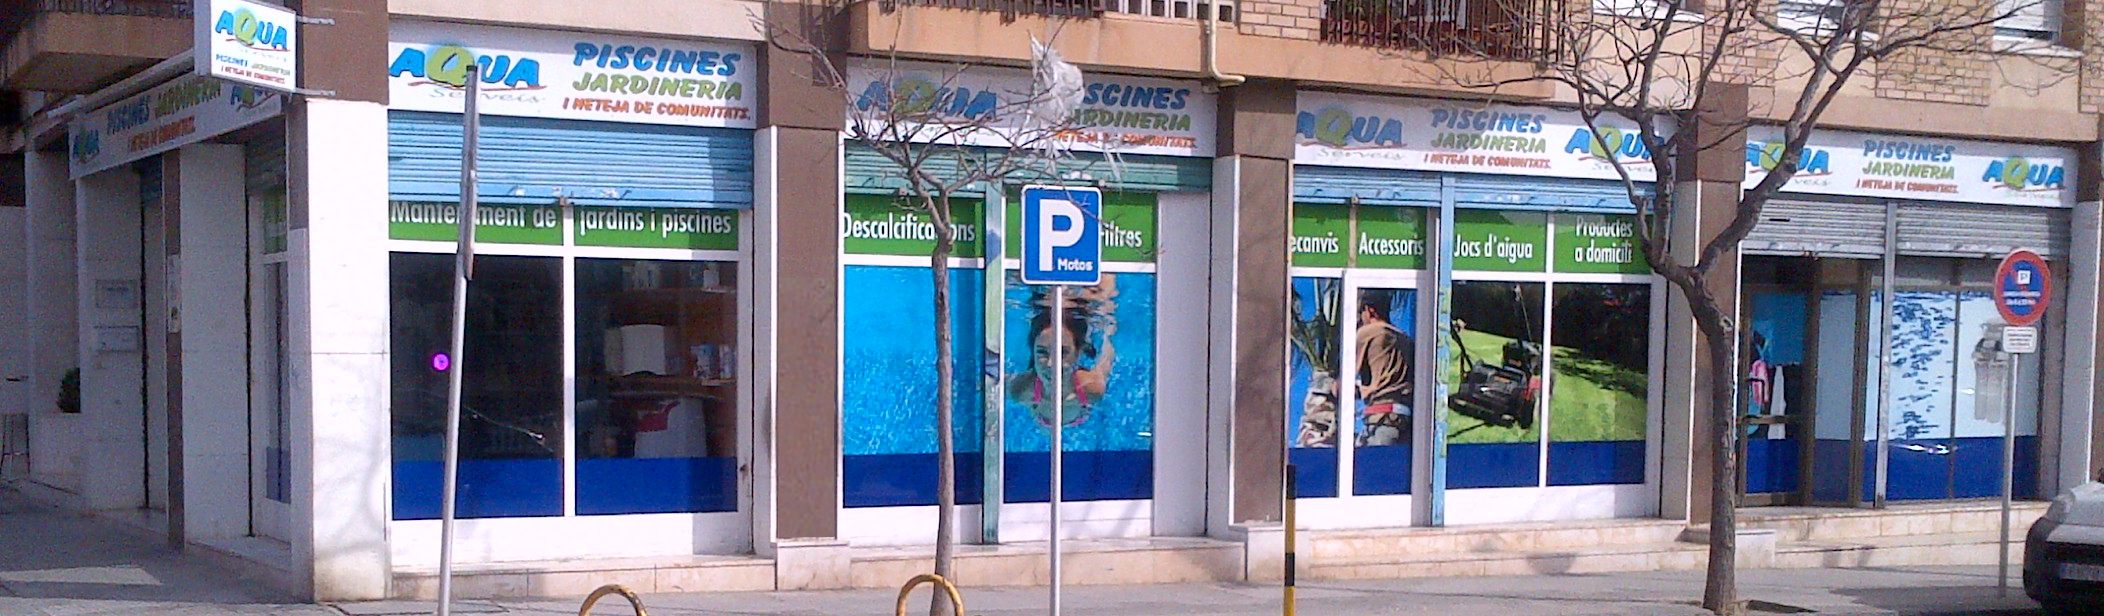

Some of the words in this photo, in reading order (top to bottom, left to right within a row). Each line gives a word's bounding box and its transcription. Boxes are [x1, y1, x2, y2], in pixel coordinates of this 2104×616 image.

[215, 10, 288, 51] AQUA
[389, 46, 541, 88] AQUA
[573, 42, 742, 77] PISCINES
[430, 88, 545, 104] Seveis
[572, 72, 742, 101] JARDINERIA
[856, 80, 998, 121] AQUA
[1082, 83, 1191, 111] SCINES
[562, 97, 569, 110] I
[572, 97, 630, 113] NETEJA
[633, 101, 654, 114] DE
[1066, 107, 1191, 132] ARDINERIA
[1431, 103, 1547, 134] PISCINES
[1296, 107, 1404, 147] AQUA
[1430, 132, 1547, 154] JARDINERIA
[1863, 139, 1956, 163] PISCINES
[1861, 160, 1955, 180] JARDINERIA
[1982, 156, 2065, 189] AQUA
[390, 201, 526, 228] Mantement
[532, 205, 557, 229] de
[580, 206, 645, 237] jardins
[650, 208, 656, 233] i
[661, 209, 733, 240] piscines
[843, 211, 976, 242] Descalcificaons
[1576, 214, 1634, 238] Productes
[1038, 198, 1085, 272] P
[1292, 231, 1340, 254] ecanvis
[1358, 231, 1424, 256] Accessoris
[1453, 234, 1481, 258] Jocs
[1484, 234, 1534, 264] d'aigua
[1057, 258, 1094, 272] Motos
[1574, 247, 1584, 263] a
[1586, 238, 1633, 264] domicili
